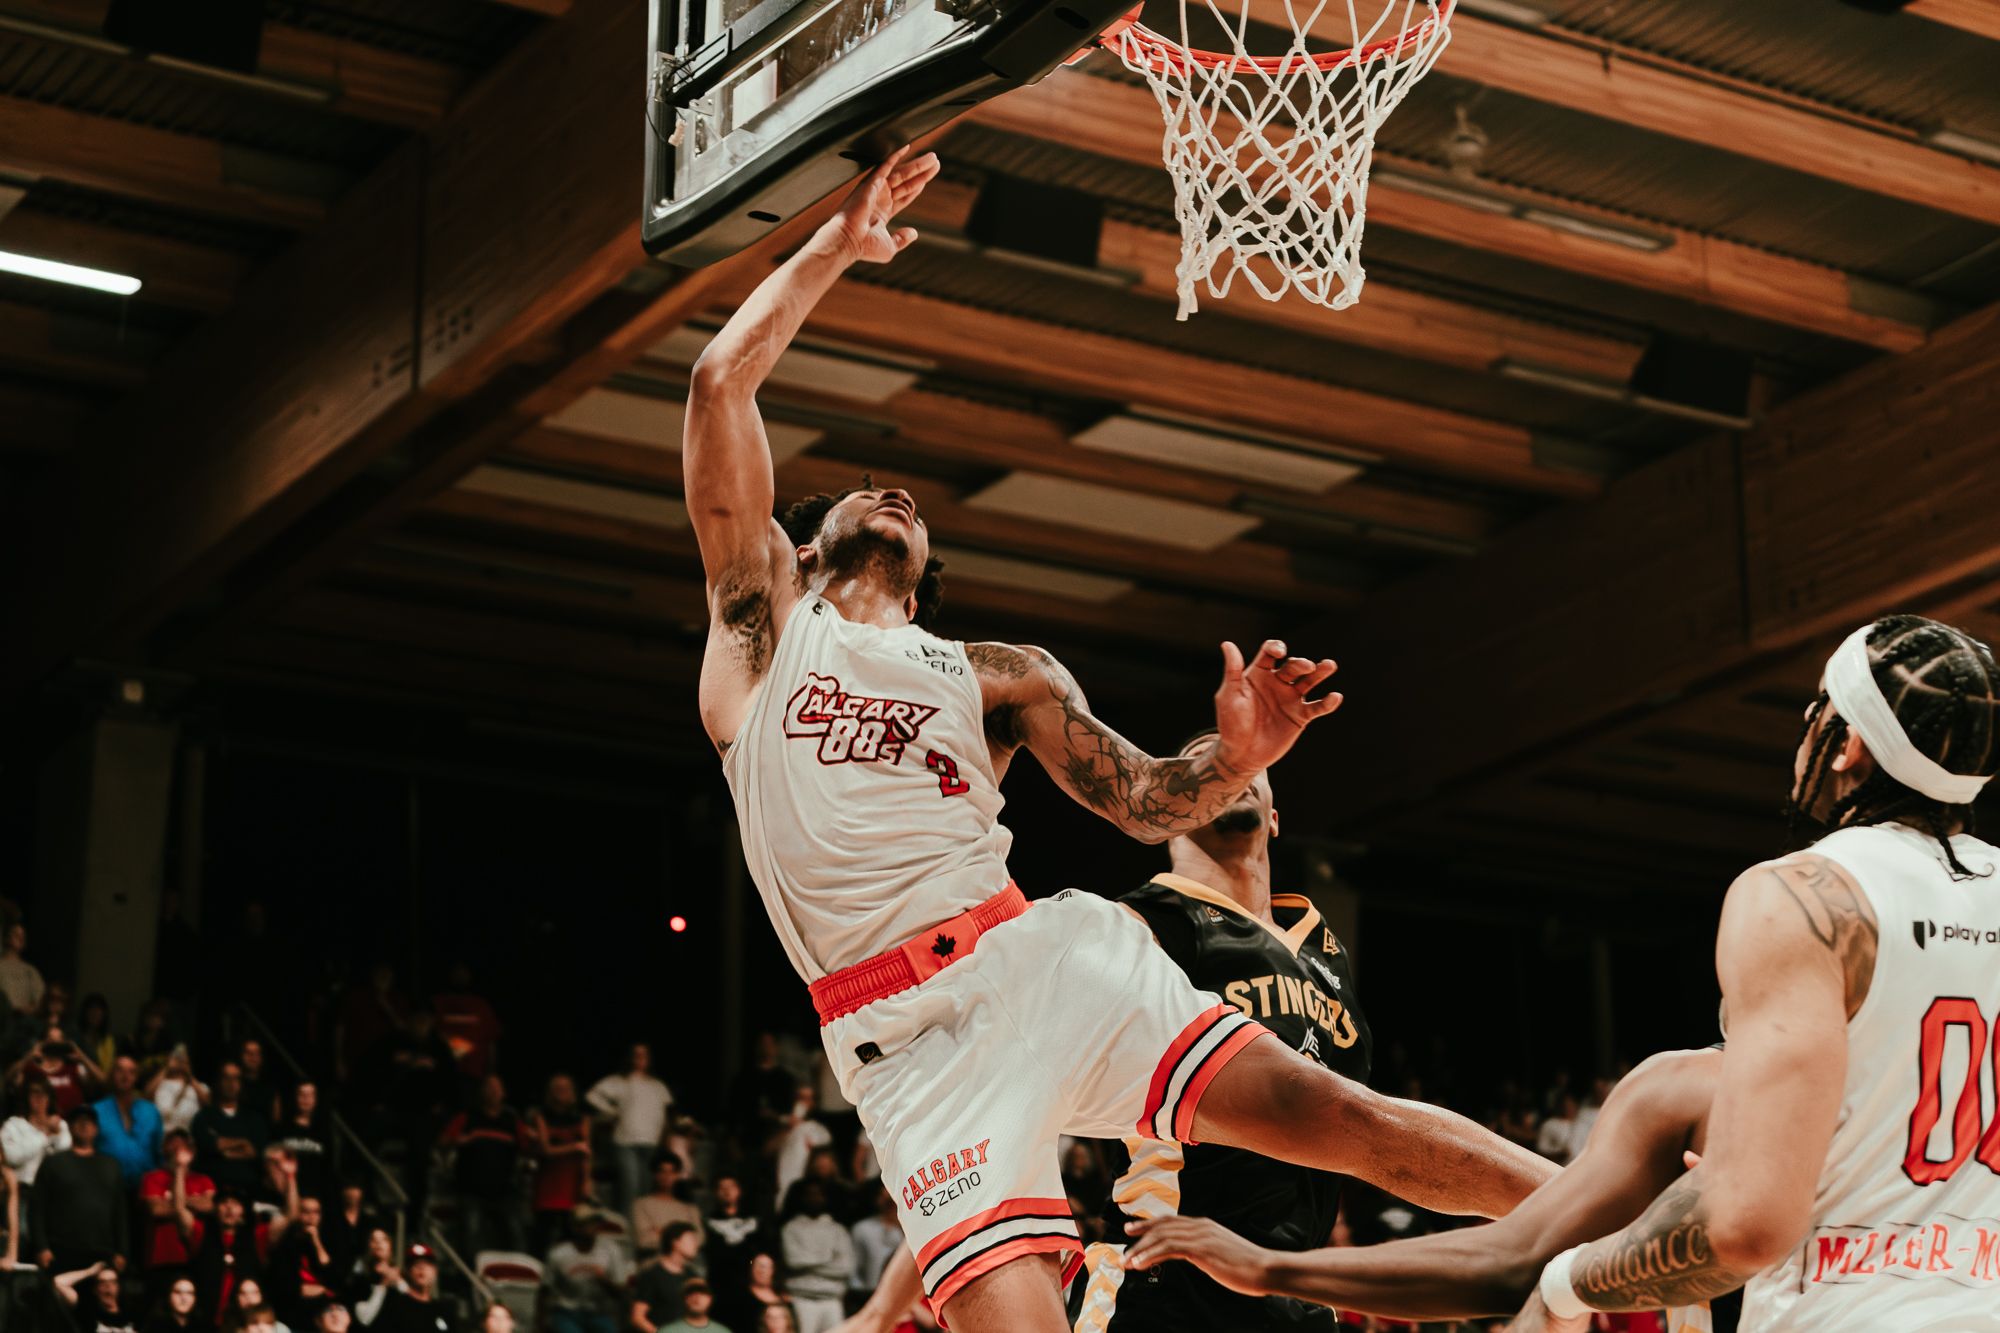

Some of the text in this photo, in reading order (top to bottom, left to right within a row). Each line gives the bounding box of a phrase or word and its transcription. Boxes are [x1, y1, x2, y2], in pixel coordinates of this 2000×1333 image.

[783, 672, 942, 742] CALGARY
[925, 748, 970, 798] 2
[1943, 922, 1981, 946] play
[903, 1138, 990, 1210] CALGARY
[935, 1171, 981, 1207] ZENO
